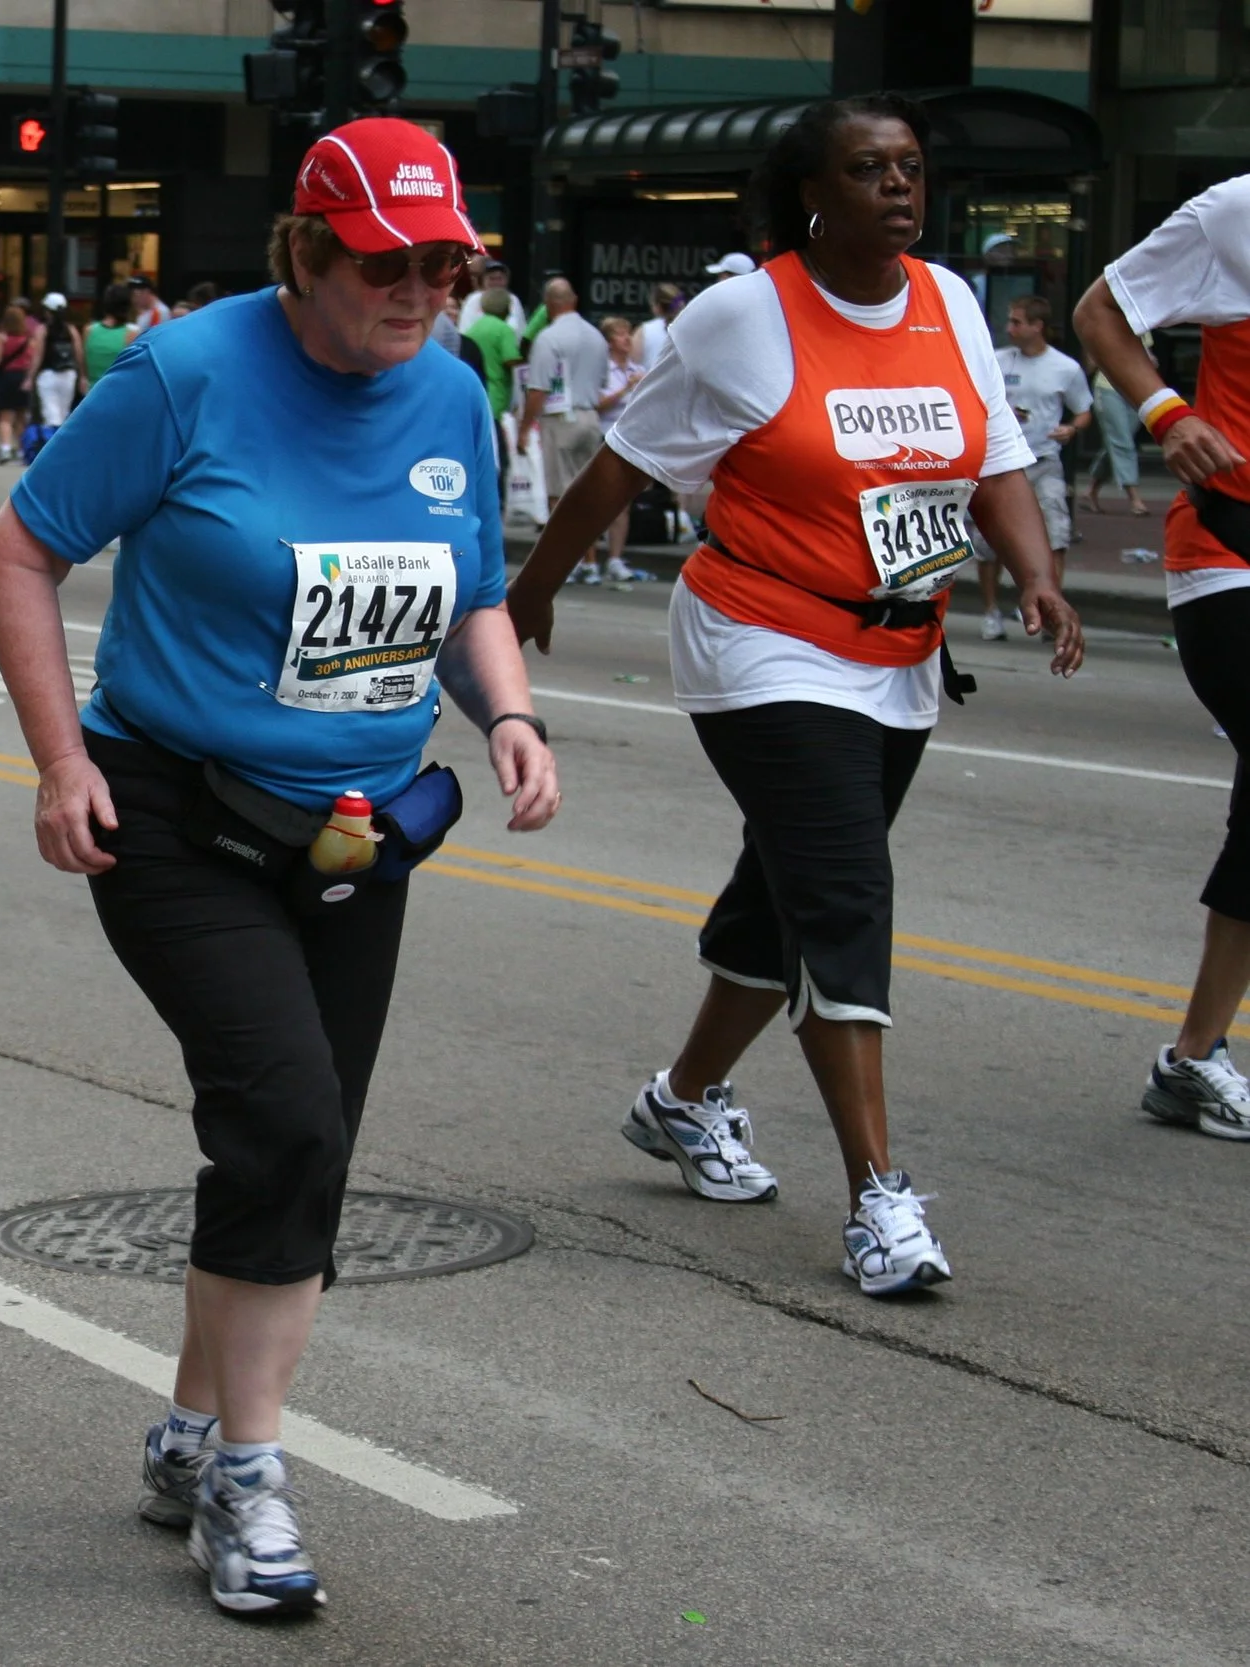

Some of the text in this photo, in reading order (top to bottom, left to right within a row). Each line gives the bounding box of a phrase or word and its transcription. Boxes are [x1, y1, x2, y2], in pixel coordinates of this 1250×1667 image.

[396, 163, 434, 180] JEANS
[389, 180, 443, 198] MARINES
[834, 402, 955, 434] BOBBIE
[930, 488, 955, 497] Bank
[873, 503, 963, 566] 34346
[346, 555, 431, 570] LaSalle Bank
[916, 546, 968, 577] ANNIVERSARY
[301, 584, 443, 648] 21474
[314, 646, 430, 675] 30th ANNIVERSARY
[298, 690, 331, 700] October
[341, 691, 358, 700] 2007
